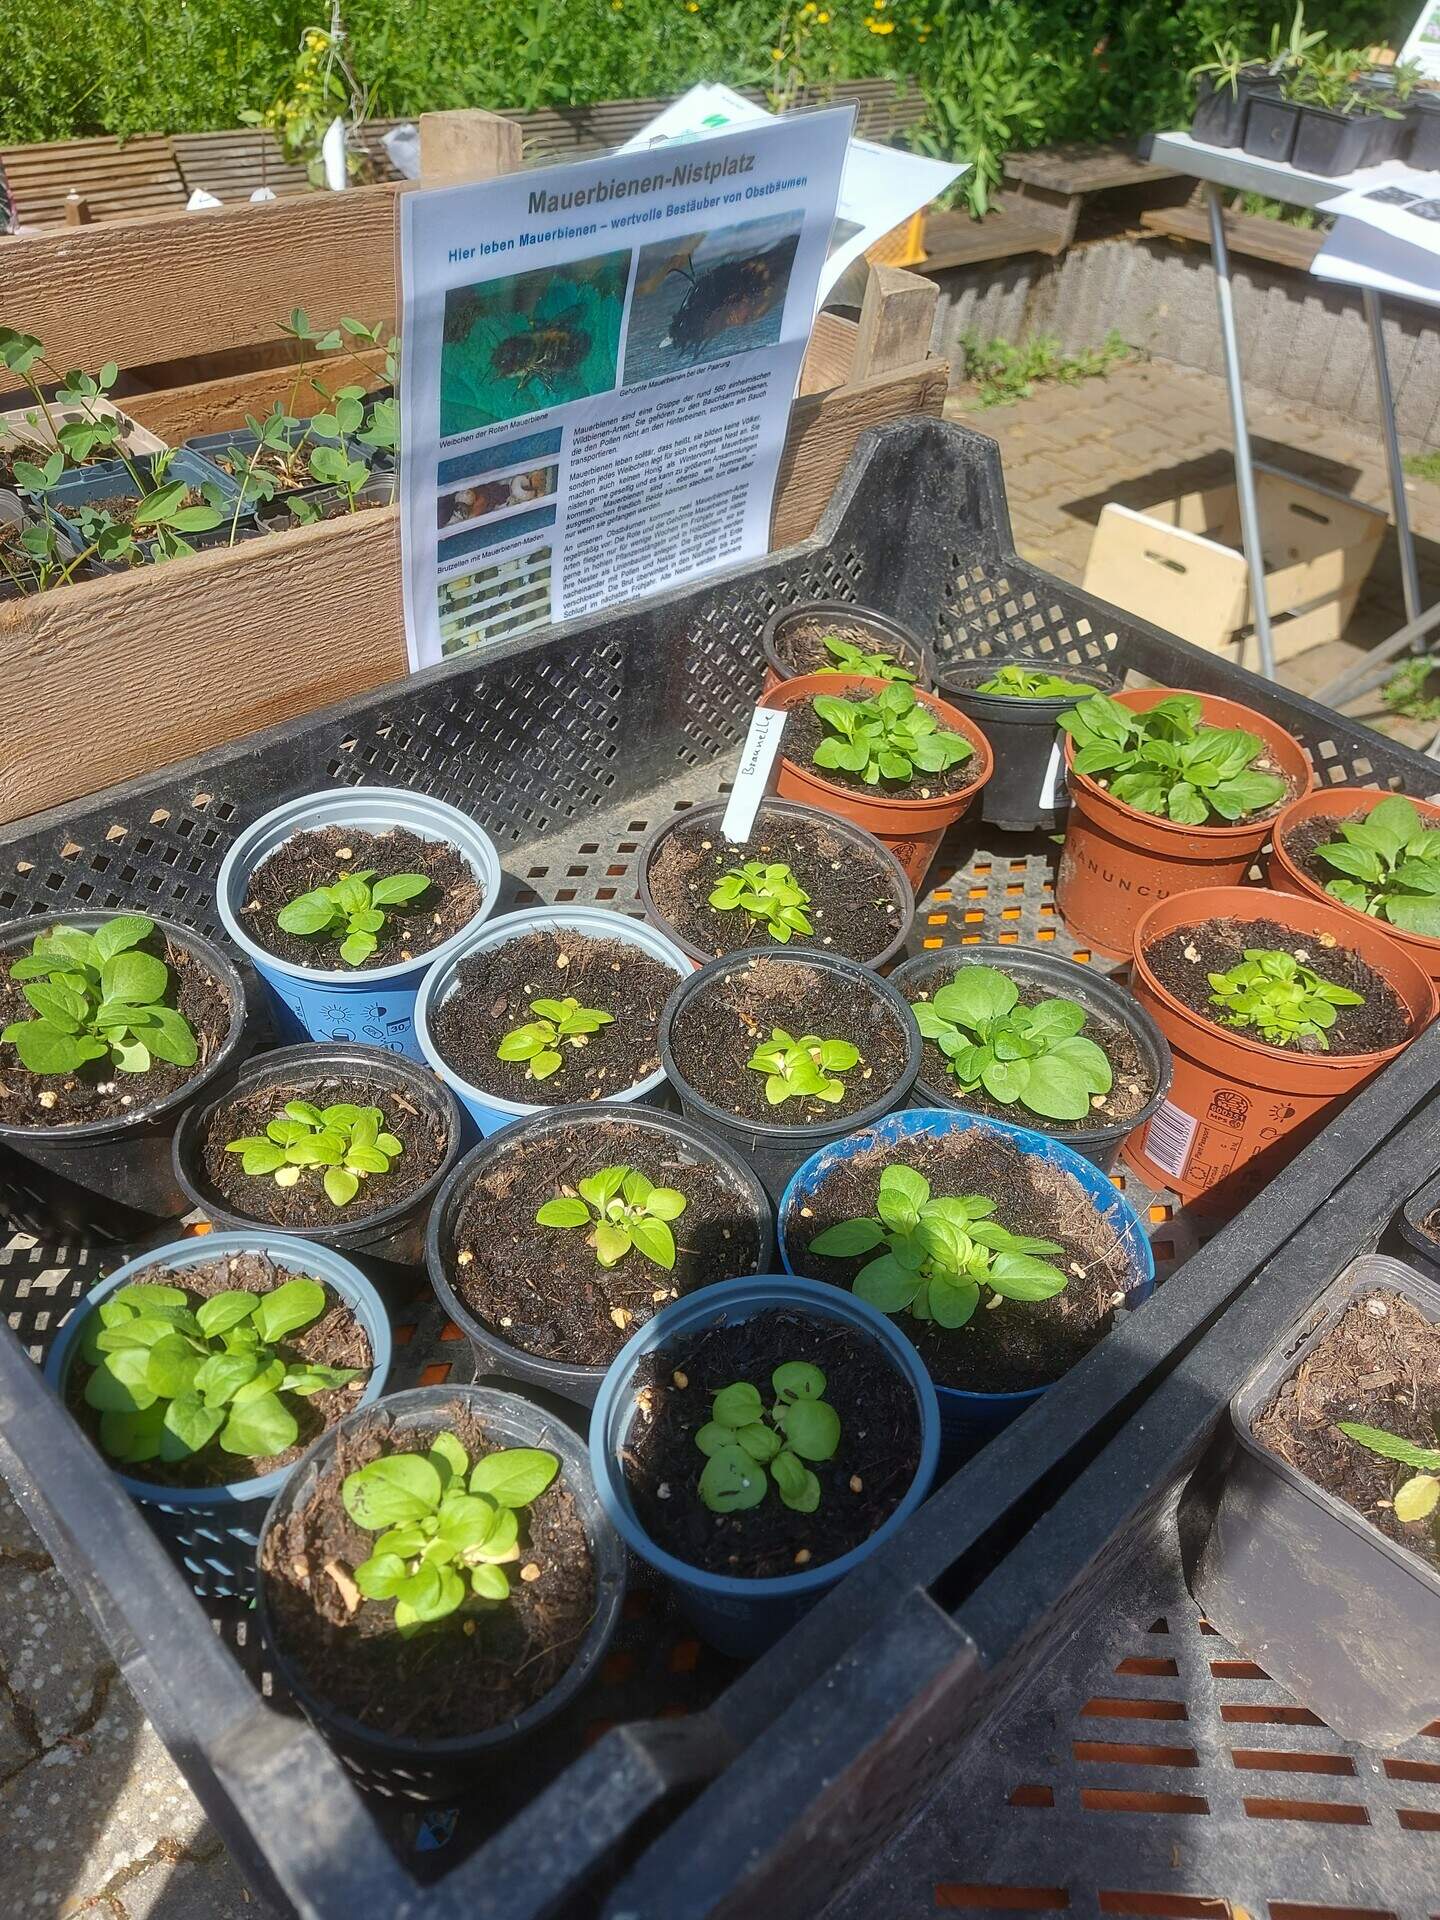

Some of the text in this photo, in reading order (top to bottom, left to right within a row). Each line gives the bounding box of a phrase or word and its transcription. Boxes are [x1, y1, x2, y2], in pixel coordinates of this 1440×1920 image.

[528, 152, 756, 215] Mauerbienen-Nistplatz
[448, 245, 474, 262] Hier
[480, 238, 514, 256] leben
[519, 222, 597, 246] Mauerbienen
[611, 209, 662, 229] wertvolle
[666, 196, 720, 218] Bestäuber
[723, 193, 742, 204] von
[746, 175, 808, 199] Obstbäumen
[648, 374, 686, 388] Mauerbienen
[440, 413, 548, 448] Weibchen der Roten Mauerbiene
[571, 448, 581, 456] die
[584, 443, 597, 452] den
[599, 436, 620, 447] Pollen
[622, 429, 639, 440] nicht
[651, 423, 664, 431] den
[709, 401, 734, 413] sondern
[747, 389, 767, 401] Bauch
[573, 417, 618, 435] Mauerbienen
[620, 410, 635, 421] sind
[638, 407, 652, 416] eine
[655, 399, 680, 411] Gruppe
[696, 388, 711, 398] rund
[634, 418, 645, 426] Sie
[648, 410, 674, 424] gehören
[687, 402, 700, 410] den
[568, 478, 595, 491] sondern
[596, 471, 615, 484] jedes
[616, 460, 649, 475] Weibchen
[650, 454, 662, 464] legt
[673, 447, 686, 457] sich
[698, 437, 722, 448] eigenes
[724, 430, 738, 440] Nest
[568, 488, 594, 501] machen
[598, 480, 614, 491] auch
[618, 473, 640, 484] keinen
[644, 465, 662, 476] Honig
[720, 434, 758, 450] Mauerbienen
[569, 462, 612, 481] Mauerbienen
[614, 456, 632, 466] leben
[657, 443, 672, 452] dass
[703, 427, 722, 438] bilden
[567, 500, 587, 511] nisten
[589, 493, 608, 505] gerne
[609, 484, 634, 498] gesellig
[635, 478, 647, 488] und
[658, 471, 673, 480] kann
[683, 458, 711, 473] größeren
[602, 490, 644, 508] Mauerbienen
[649, 482, 662, 492] sind
[675, 471, 698, 483] ebenso
[564, 531, 576, 539] nur
[577, 524, 594, 534] wenn
[606, 510, 636, 526] gefangen
[565, 508, 615, 530] ausgesprochen
[644, 492, 662, 502] Beide
[664, 484, 687, 496] können
[562, 561, 580, 571] Arten
[582, 552, 604, 564] fliegen
[630, 535, 651, 546] wenige
[654, 525, 678, 538] Wochen
[563, 545, 598, 562] regelmäßig
[626, 530, 640, 539] Rote
[642, 524, 654, 533] und
[576, 534, 602, 548] unseren
[606, 519, 645, 537] Obstbäumen
[648, 508, 675, 522] kommen
[437, 559, 469, 574] Brutzellen
[482, 534, 544, 558] Mauerbienen-Maden
[562, 569, 581, 582] gerne
[591, 558, 612, 569] hohlen
[562, 580, 604, 600] nacheinander
[607, 574, 618, 583] mit
[620, 567, 639, 578] Pollen
[642, 560, 653, 570] und
[577, 573, 598, 585] Nester
[607, 584, 618, 592] Die
[621, 577, 634, 587] Brut
[563, 604, 587, 618] Schlupf
[390, 1024, 404, 1032] 30
